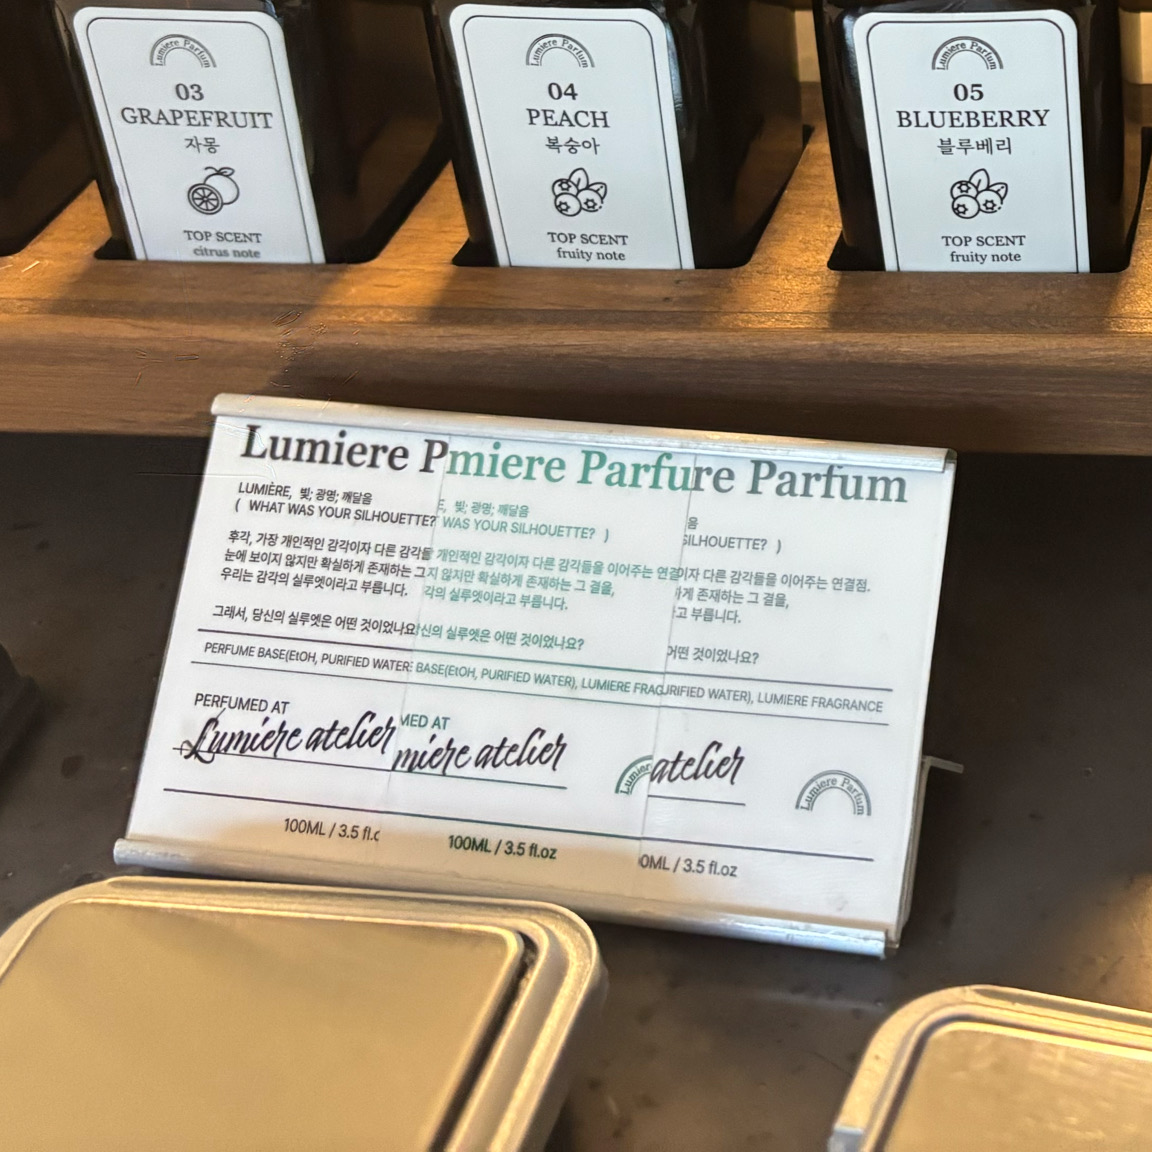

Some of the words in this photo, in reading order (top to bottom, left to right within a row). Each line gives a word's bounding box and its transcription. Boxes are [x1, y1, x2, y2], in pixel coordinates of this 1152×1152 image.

[175, 83, 205, 101] 03
[548, 82, 579, 101] 04
[953, 83, 985, 101] 05
[121, 107, 273, 129] GRAPEFRUIT
[526, 108, 610, 128] PEACH
[896, 108, 1051, 129] BLUEBERRY
[185, 136, 220, 154] 자몽
[545, 136, 601, 155] 복숭아
[937, 136, 1012, 156] 블루베리
[183, 230, 212, 242] TOP
[216, 232, 262, 243] SCENT
[547, 232, 576, 244] TOP
[580, 234, 629, 246] SCENT
[941, 235, 972, 247] TOP
[976, 235, 1027, 247] SCENT
[193, 245, 229, 259] citrus
[233, 247, 261, 259] note
[557, 248, 593, 262] fruity
[596, 250, 626, 261] note
[950, 251, 987, 265] fruity
[991, 252, 1022, 262] note
[241, 424, 409, 472] Lumiere
[746, 459, 908, 503] Parfum
[248, 499, 287, 514] WHAT
[288, 502, 315, 517] WAS
[318, 504, 351, 520] YOUR
[474, 518, 507, 533] YOUR
[510, 522, 596, 540] SILHOUETTE?
[204, 642, 255, 657] PERFUME
[320, 652, 369, 669] PURIFIED
[481, 668, 530, 683] PURIFIED
[581, 678, 631, 693] LUMIERE
[194, 693, 268, 712] PERFUMED
[271, 700, 290, 715] AT
[757, 692, 808, 707] LUMIERE
[811, 697, 883, 713] FRAGRANCE
[305, 710, 396, 755] atelier
[431, 716, 450, 730] AT
[475, 726, 567, 771] atelier
[650, 739, 745, 786] atelier
[284, 818, 326, 838] 100ML
[338, 824, 360, 839] 3.5
[448, 834, 491, 854] 100ML
[504, 840, 525, 857] 3.5
[527, 841, 557, 861] fl.oz
[683, 858, 705, 875] 3.5
[707, 859, 738, 879] fl.oz
